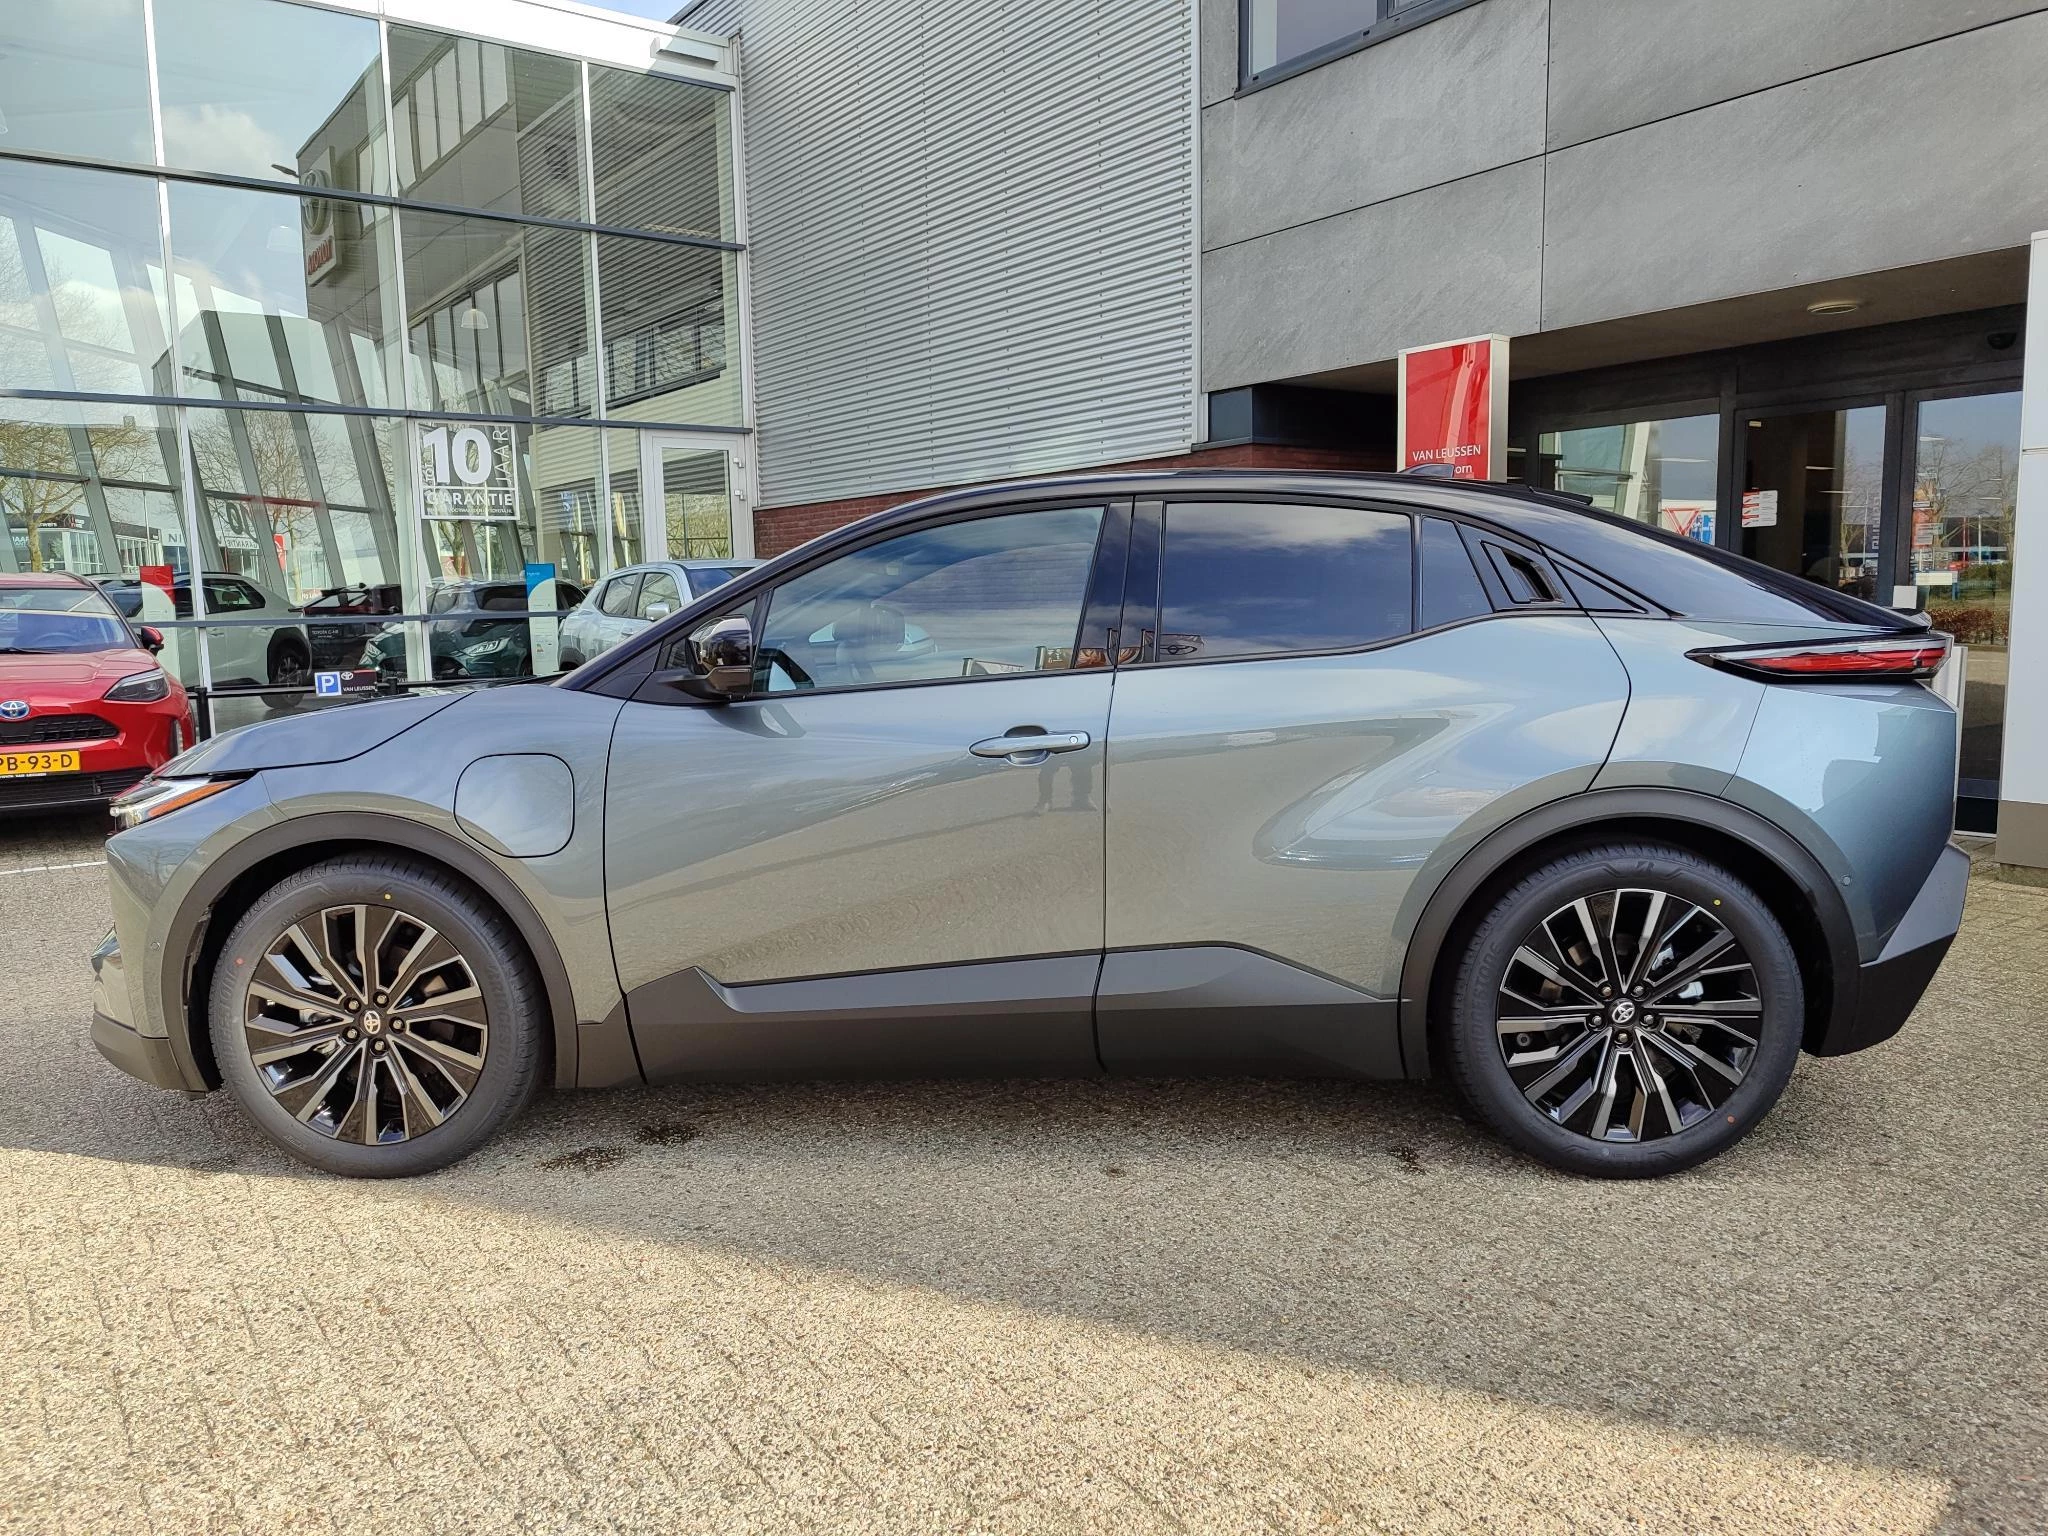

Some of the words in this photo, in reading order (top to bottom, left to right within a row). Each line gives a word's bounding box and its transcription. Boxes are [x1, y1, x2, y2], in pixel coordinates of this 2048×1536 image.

[423, 427, 492, 484] 10
[492, 429, 512, 484] JAAR
[1412, 449, 1433, 461] VAN
[1435, 444, 1481, 459] LEUSSEN
[426, 491, 513, 506] GARANTIE
[321, 675, 335, 693] P
